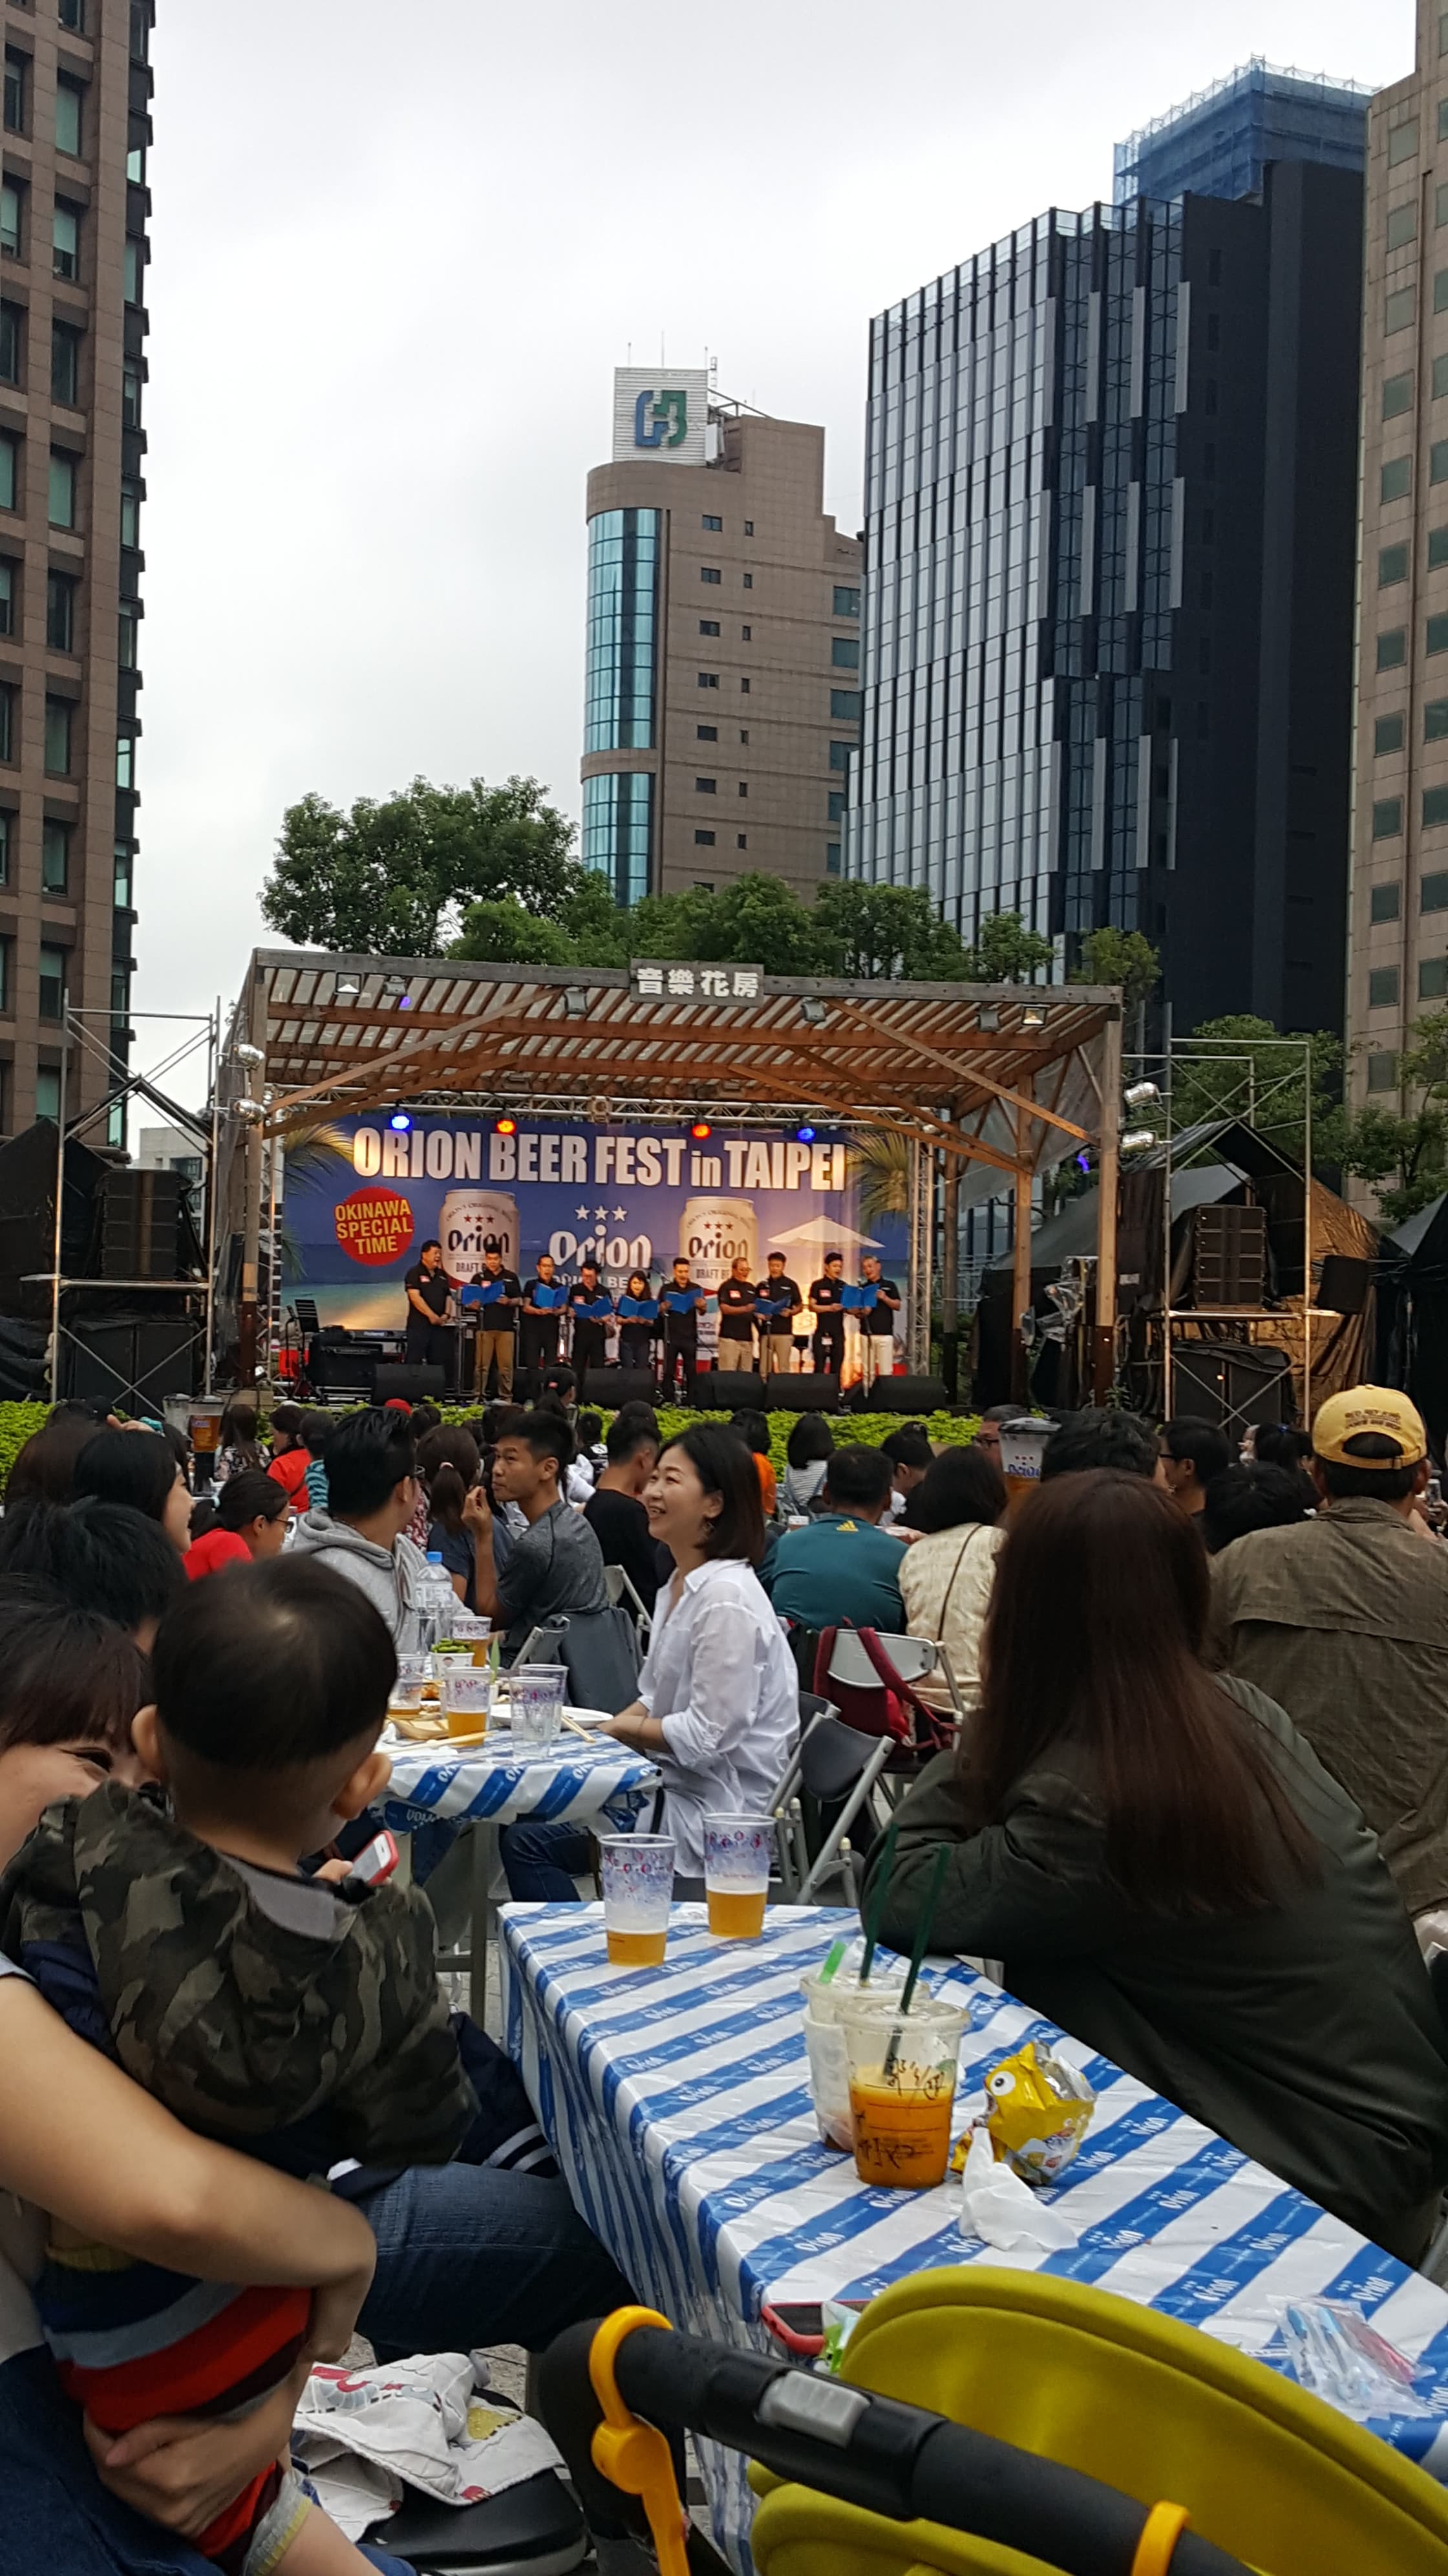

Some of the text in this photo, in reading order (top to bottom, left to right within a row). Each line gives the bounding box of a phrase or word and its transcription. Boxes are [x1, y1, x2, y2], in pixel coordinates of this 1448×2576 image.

[637, 968, 759, 998] 音樂花房
[353, 1127, 845, 1191] ORION BEER FEST in TAIPEI
[335, 1199, 411, 1221] OKINAWA
[336, 1217, 413, 1239] SPECIAL
[354, 1236, 398, 1254] TIME
[549, 1224, 652, 1269] Orion
[688, 1231, 748, 1259] Orion
[456, 1262, 479, 1272] DRAFT
